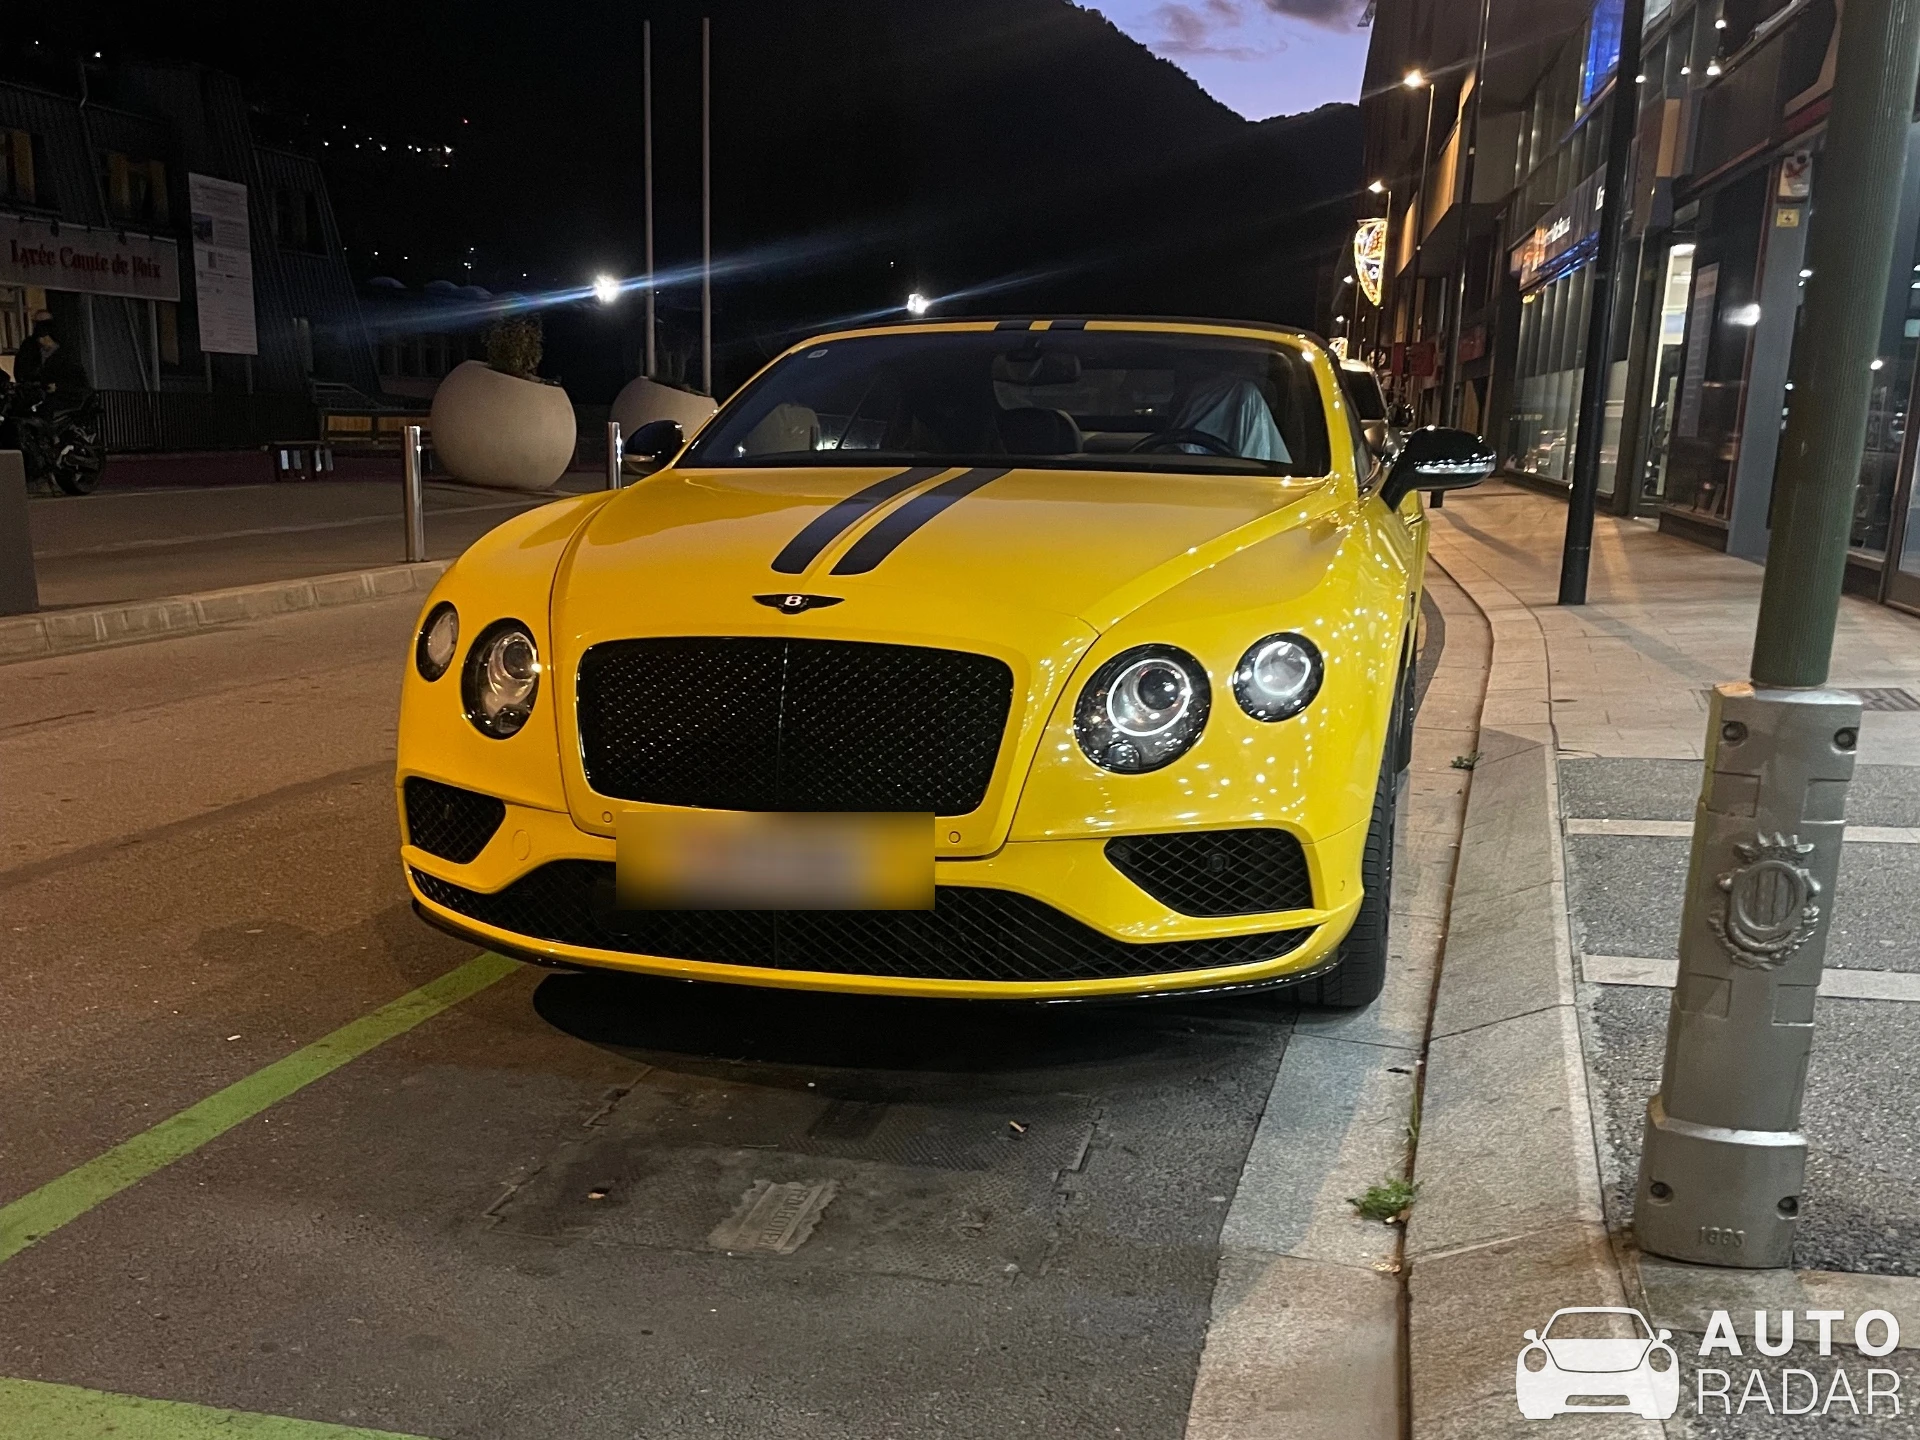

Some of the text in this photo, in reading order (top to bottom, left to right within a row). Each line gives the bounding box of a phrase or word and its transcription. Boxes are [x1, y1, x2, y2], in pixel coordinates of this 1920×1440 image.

[60, 246, 109, 273] Comte
[112, 253, 129, 276] de
[132, 255, 161, 279] Foix
